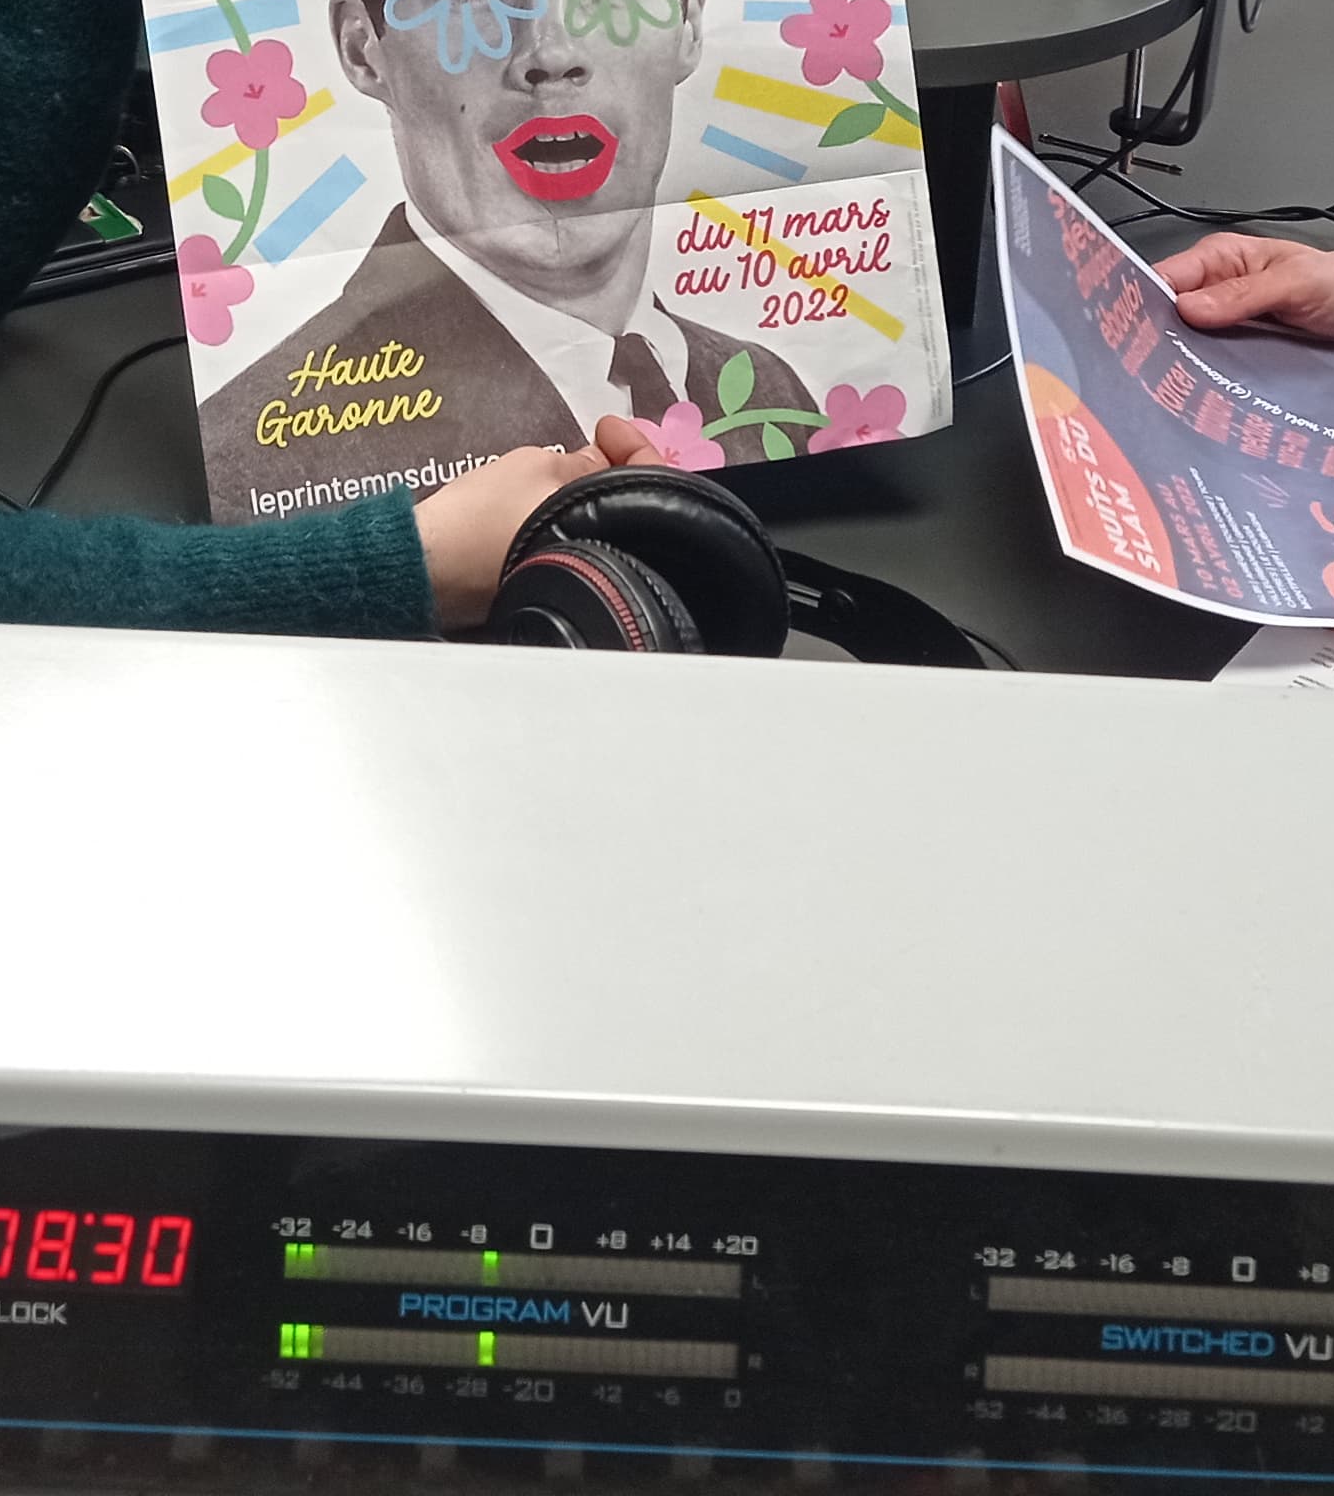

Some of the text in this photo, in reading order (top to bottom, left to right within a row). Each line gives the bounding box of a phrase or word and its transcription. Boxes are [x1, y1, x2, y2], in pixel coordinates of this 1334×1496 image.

[676, 197, 891, 255] du 11 mars
[674, 232, 892, 296] au 10 avril
[757, 283, 850, 330] 2022
[286, 339, 426, 398] Haute
[255, 388, 444, 448] Garonne
[1108, 478, 1162, 575] SLAM
[399, 1292, 630, 1329] PROGRAM VU
[1101, 1324, 1334, 1361] SWITCHED VU
